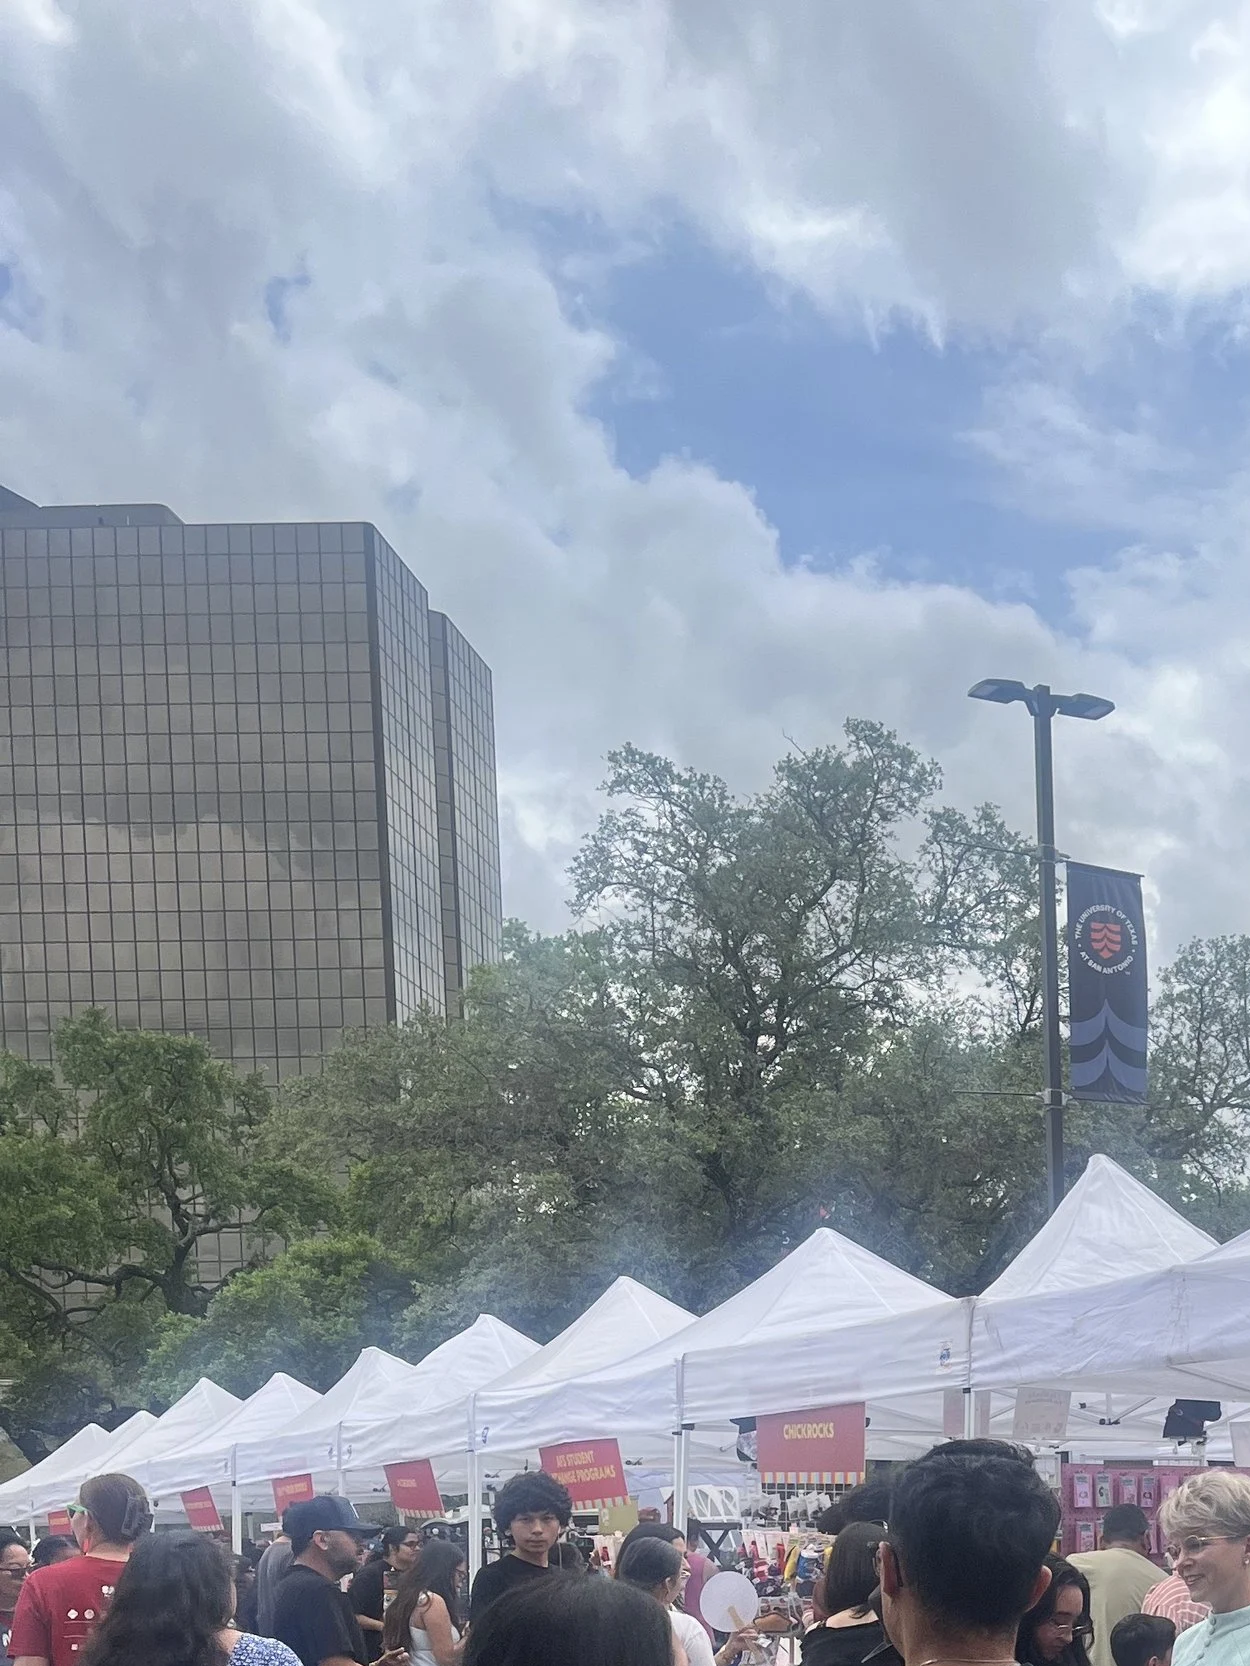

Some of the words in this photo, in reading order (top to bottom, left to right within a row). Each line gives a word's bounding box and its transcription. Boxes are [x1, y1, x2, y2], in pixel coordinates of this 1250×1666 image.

[1074, 922, 1083, 940] THE
[1079, 904, 1116, 923] UNIVERSITY
[1116, 910, 1127, 920] OF
[1125, 919, 1139, 946] TEXAS
[1080, 951, 1090, 961] AT
[1087, 959, 1103, 972] SAN
[1102, 955, 1134, 974] ANTONIO
[783, 1422, 834, 1440] CHICKROCKS
[567, 1450, 595, 1466] STUDENT
[575, 1464, 616, 1482] PROGRAMS
